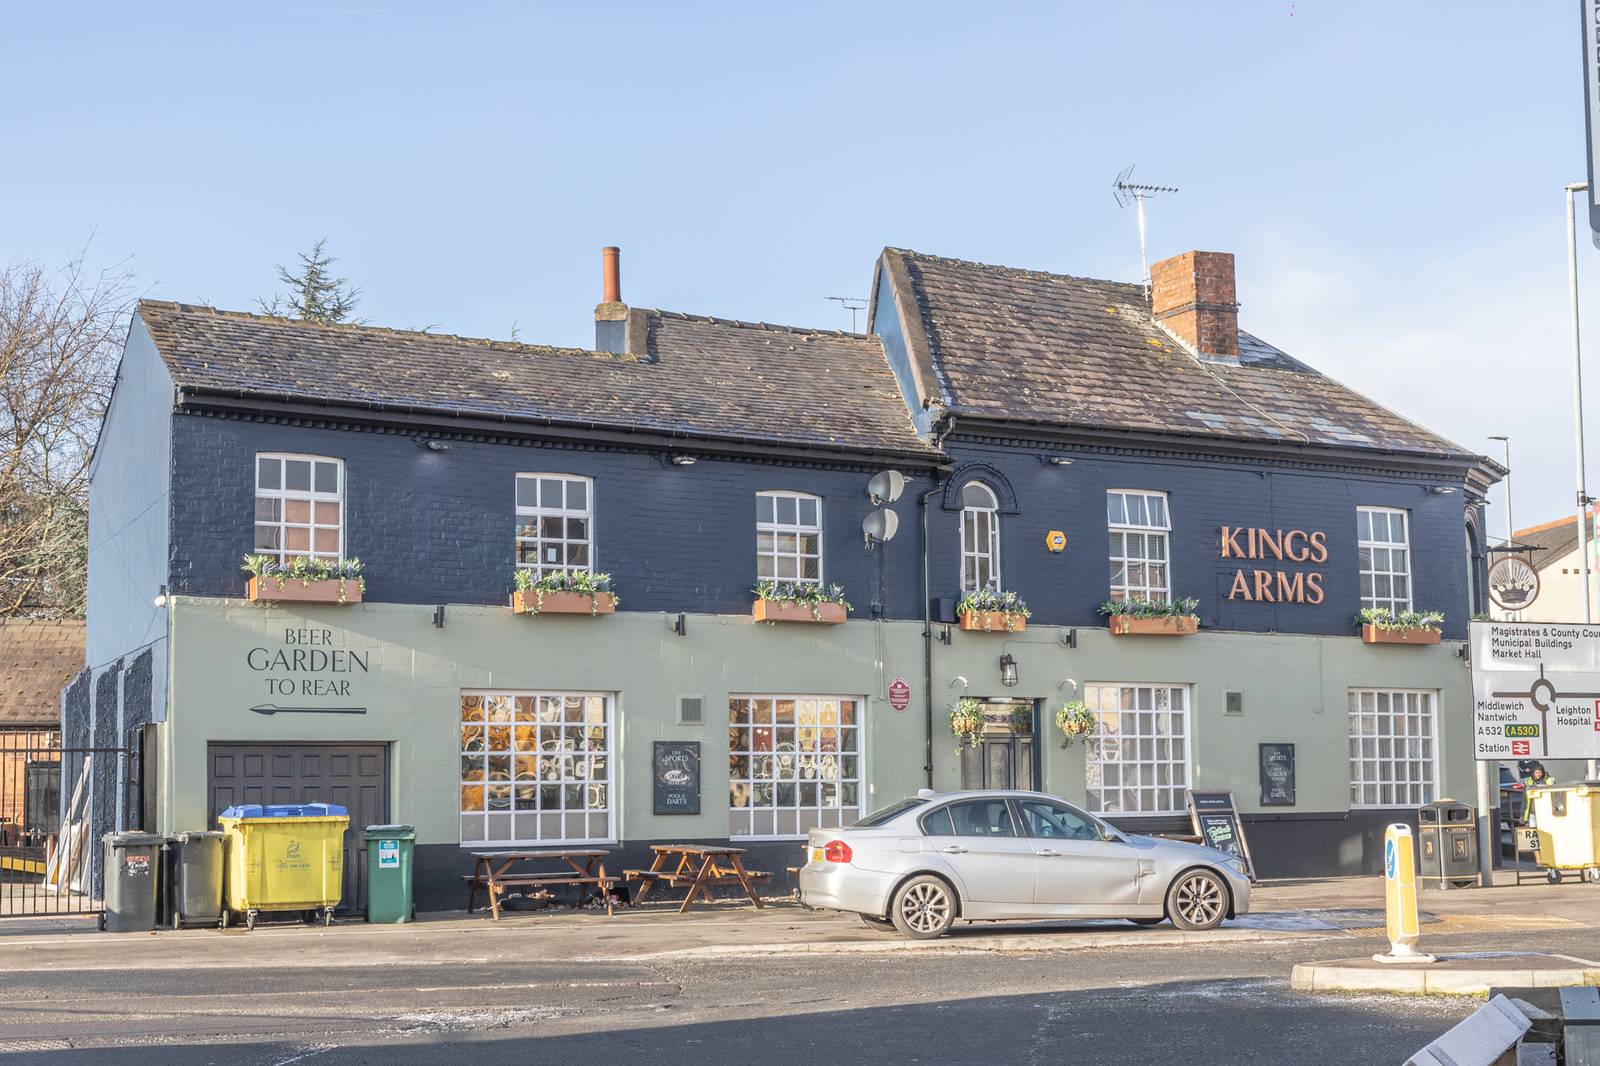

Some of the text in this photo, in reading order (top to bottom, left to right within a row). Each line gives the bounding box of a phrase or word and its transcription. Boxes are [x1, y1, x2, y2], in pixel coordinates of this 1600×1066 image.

[1221, 526, 1328, 563] KINGS
[1227, 569, 1325, 605] ARMS
[285, 628, 332, 646] BEER
[1491, 627, 1540, 638] Magistrates
[1543, 628, 1549, 637] &
[1551, 628, 1580, 639] County
[1492, 638, 1573, 650] Municipal Buildings
[1492, 649, 1542, 659] Market Hall
[247, 648, 369, 673] GARDEN
[265, 678, 351, 697] TO REAR
[1478, 701, 1524, 711] Middlewich
[1556, 706, 1591, 716] Leighton
[1478, 712, 1517, 721] Nantwich
[1557, 717, 1592, 727] Hospital
[1478, 726, 1539, 737] A532 (A530)
[1479, 743, 1510, 753] Station
[1525, 830, 1539, 839] RA
[1530, 839, 1540, 848] ST
